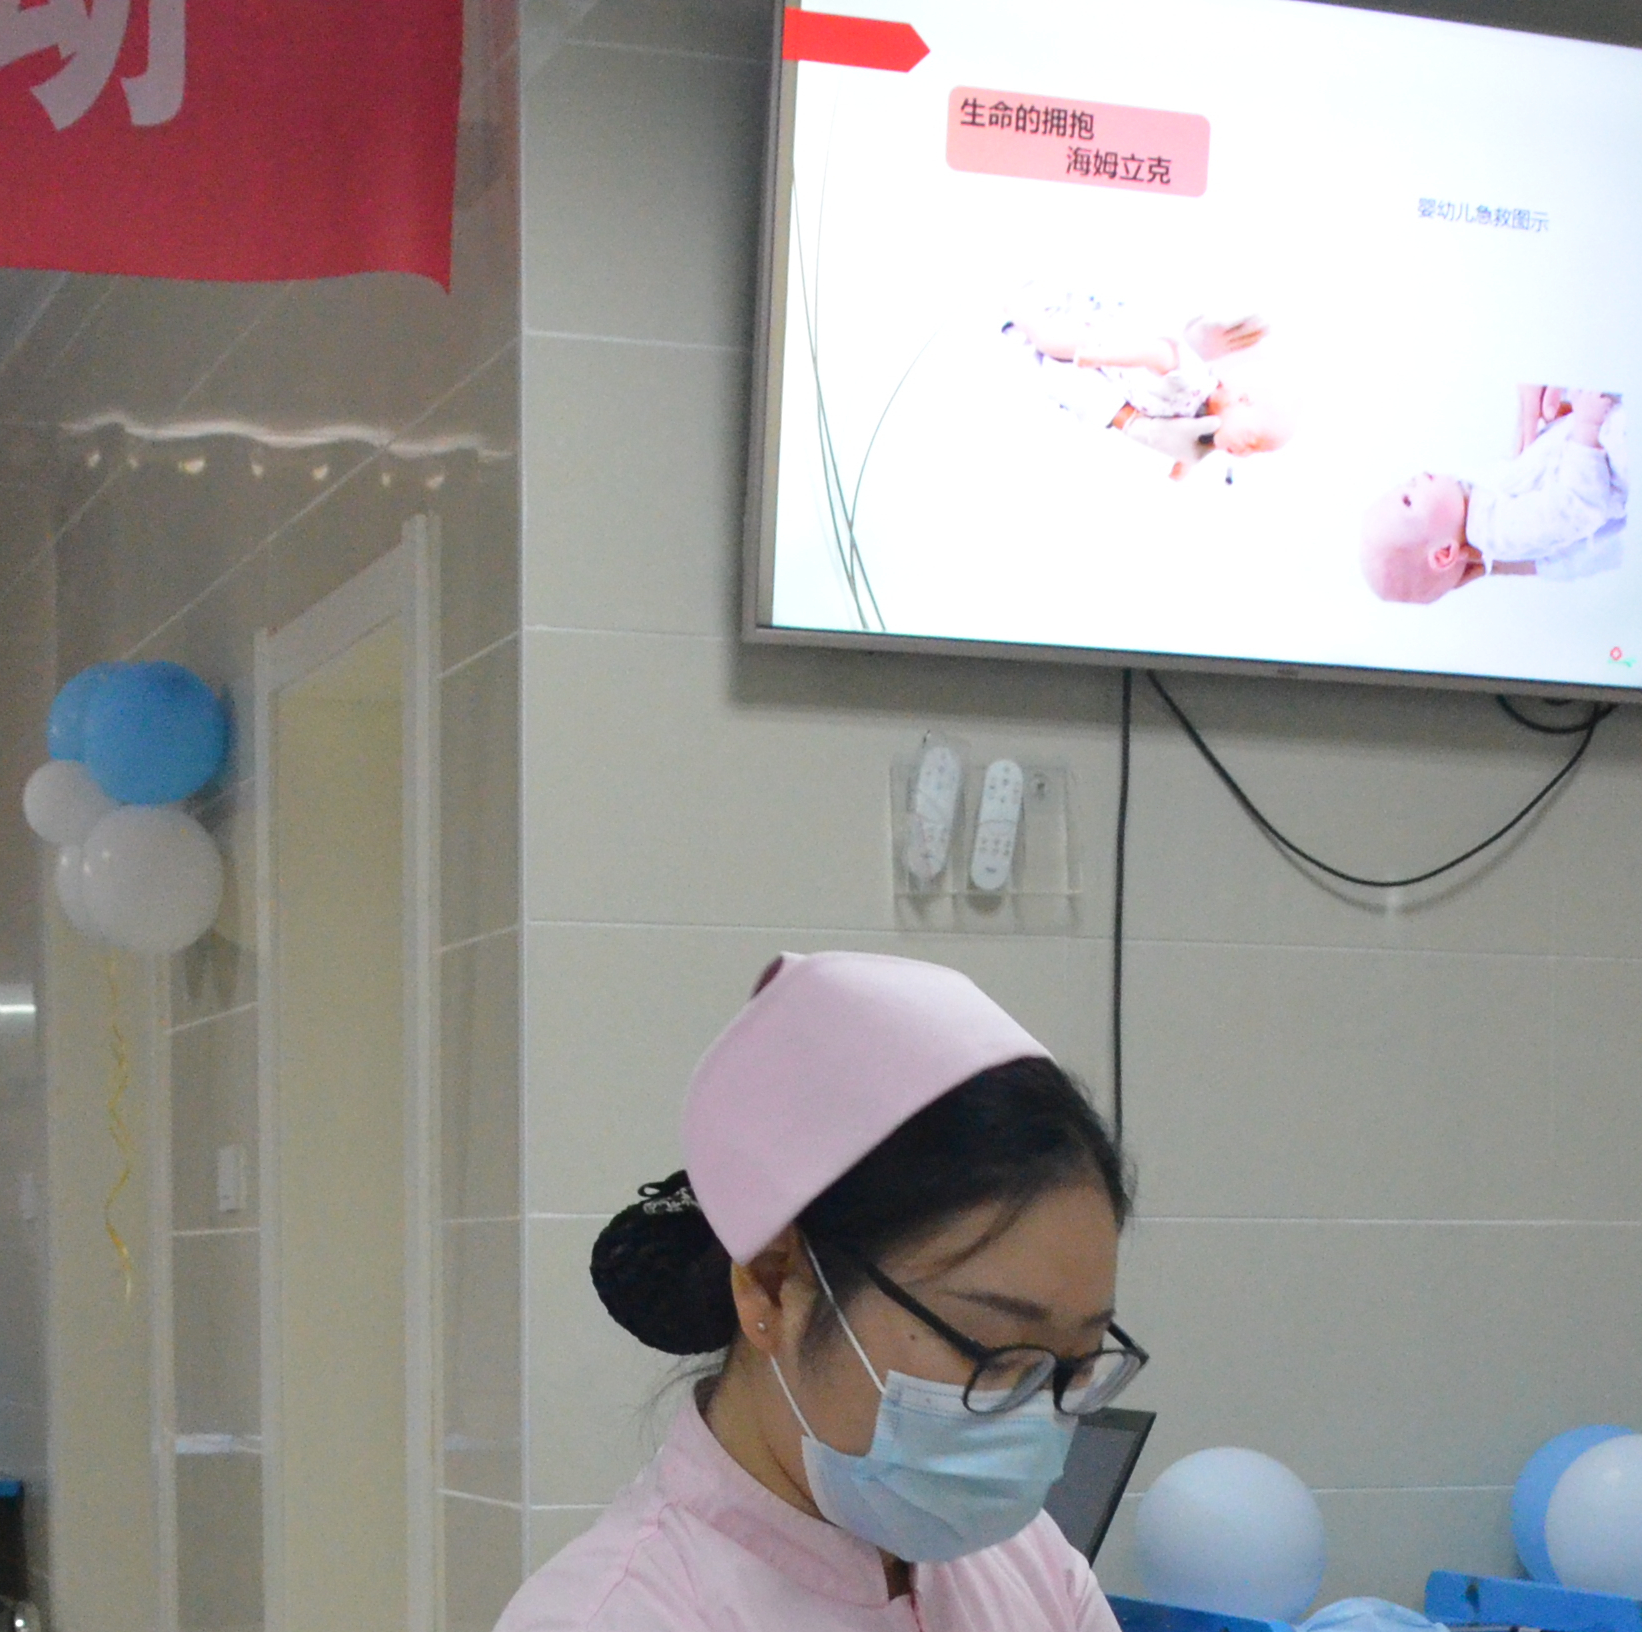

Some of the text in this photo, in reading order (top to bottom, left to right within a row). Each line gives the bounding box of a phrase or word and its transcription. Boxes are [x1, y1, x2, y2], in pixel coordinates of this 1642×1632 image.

[960, 97, 1095, 140] 生命的拥抱
[1066, 145, 1172, 185] 海姆立克
[1417, 197, 1551, 233] 婴幼儿急救图示
